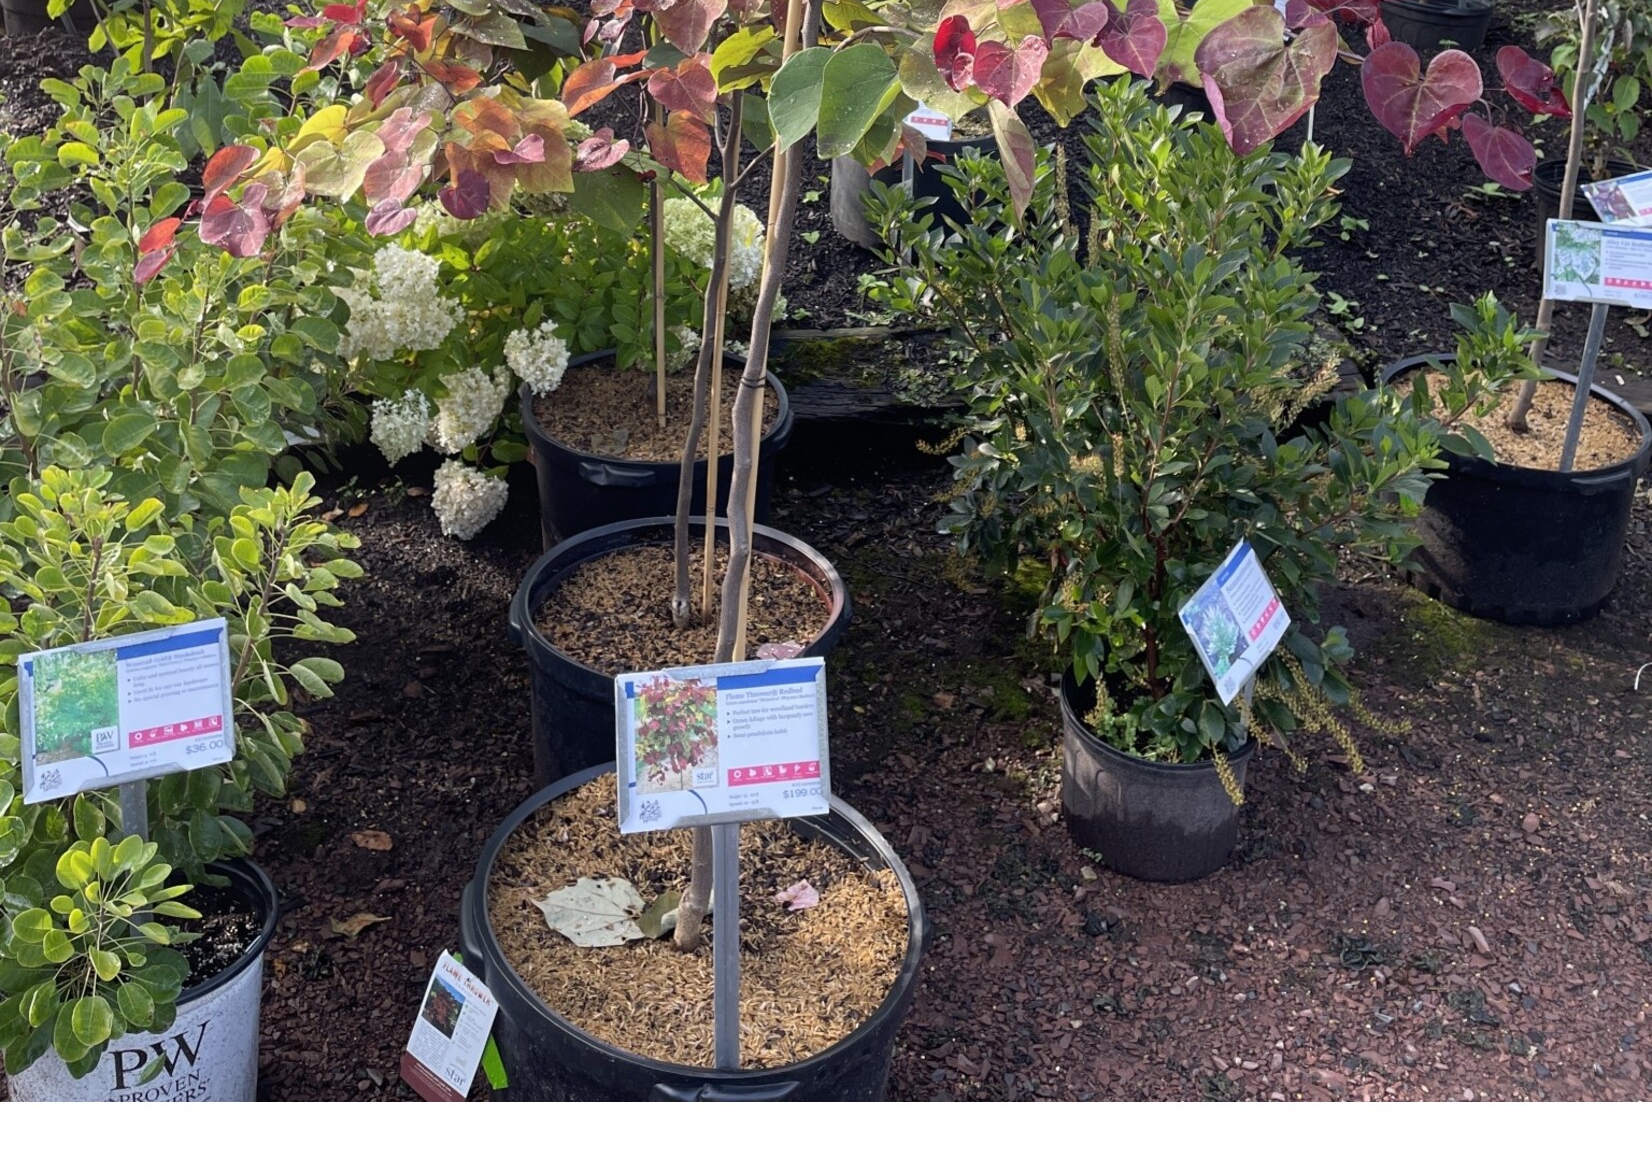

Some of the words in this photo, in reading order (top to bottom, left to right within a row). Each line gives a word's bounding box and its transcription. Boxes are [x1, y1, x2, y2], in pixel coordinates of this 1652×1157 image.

[185, 739, 223, 754] $36.00
[108, 1020, 210, 1091] PW
[120, 1068, 200, 1101] PROVEN
[444, 1067, 464, 1086] star
